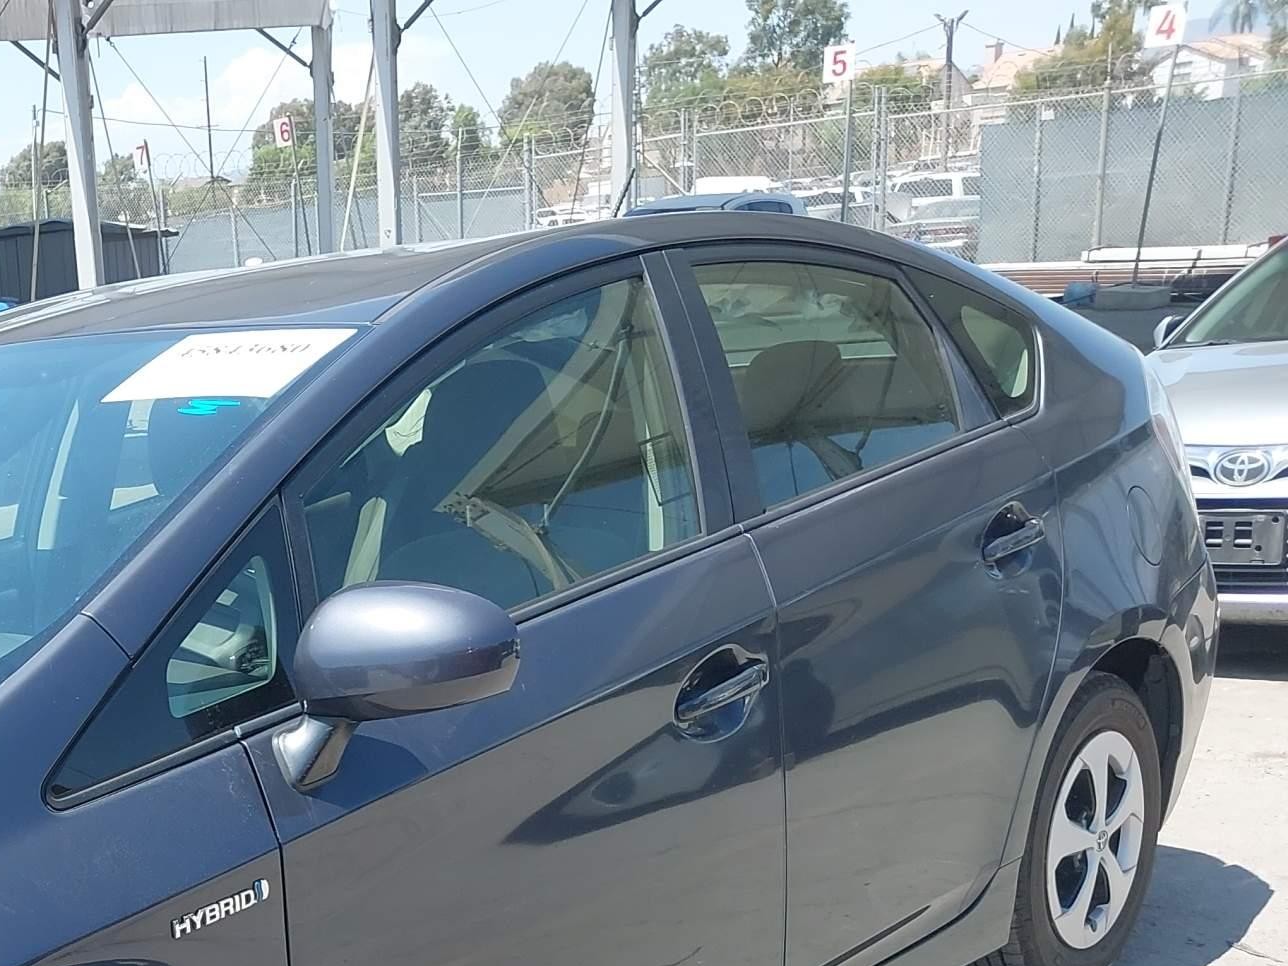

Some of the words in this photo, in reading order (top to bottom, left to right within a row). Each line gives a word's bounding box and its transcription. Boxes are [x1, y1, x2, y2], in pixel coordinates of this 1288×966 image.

[1155, 10, 1177, 40] 4
[831, 50, 848, 77] 5
[279, 121, 291, 143] 6
[135, 145, 146, 166] 7
[172, 888, 258, 939] HYBRID
